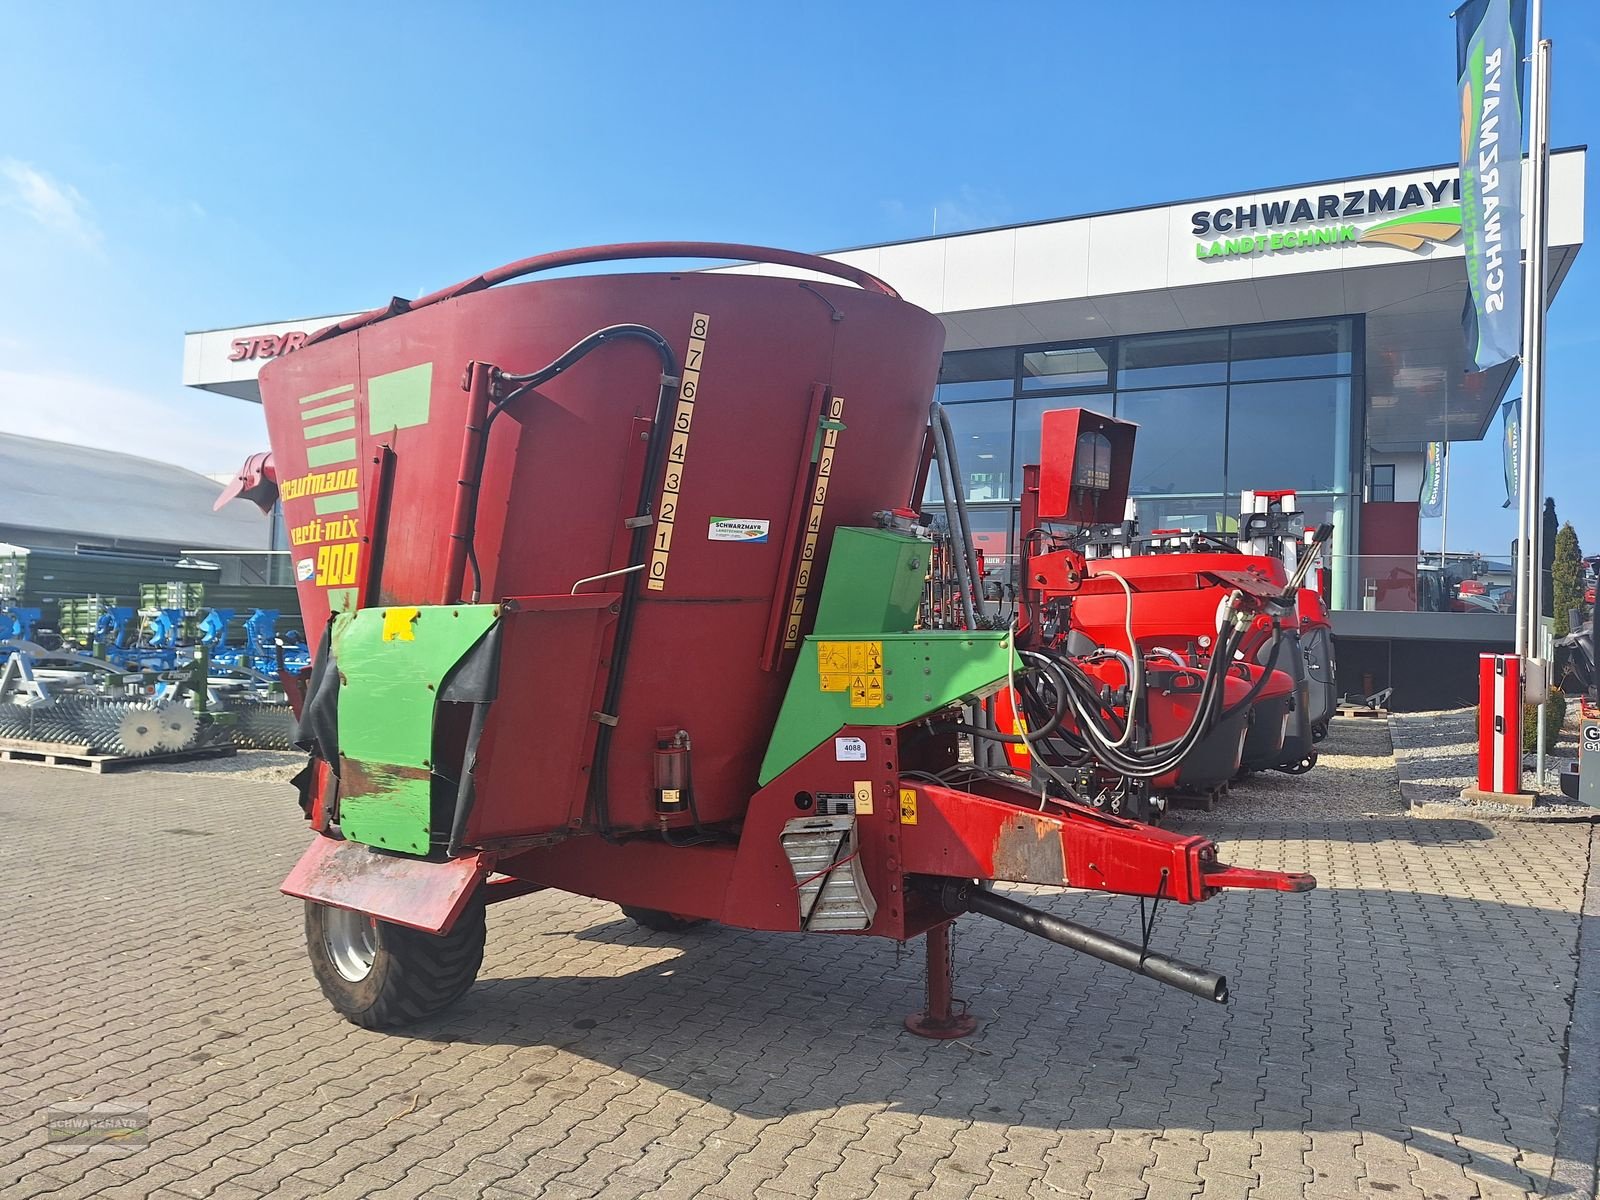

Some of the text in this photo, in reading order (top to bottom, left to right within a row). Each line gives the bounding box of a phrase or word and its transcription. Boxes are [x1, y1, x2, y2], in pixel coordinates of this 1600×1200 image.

[1195, 224, 1356, 259] LANDTECHNIK
[693, 319, 706, 337] 8
[227, 332, 308, 361] STEYR
[689, 349, 702, 367] 7
[683, 380, 695, 398] 6
[831, 400, 842, 417] 0
[677, 412, 690, 429] 5
[828, 429, 835, 446] 1
[671, 443, 684, 460] 4
[820, 457, 831, 474] 2
[666, 473, 679, 490] 3
[815, 486, 826, 503] 3
[661, 502, 675, 520] 2
[715, 522, 762, 530] SCHWARZMAYR
[810, 514, 819, 530] 4
[658, 531, 666, 549] 1
[804, 542, 814, 558] 5
[315, 543, 360, 586] 900
[652, 561, 665, 577] 0
[799, 569, 808, 585] 6
[788, 623, 798, 639] 8
[844, 744, 861, 752] 4088
